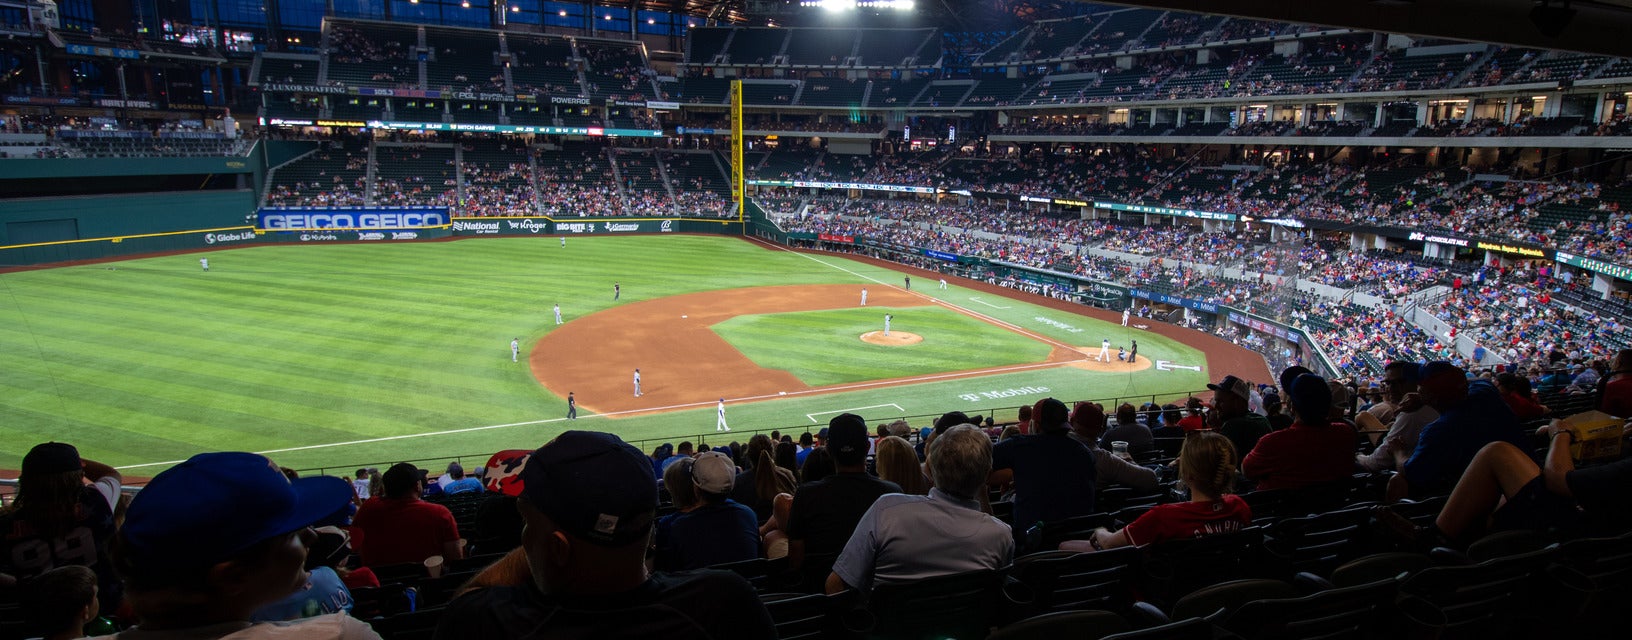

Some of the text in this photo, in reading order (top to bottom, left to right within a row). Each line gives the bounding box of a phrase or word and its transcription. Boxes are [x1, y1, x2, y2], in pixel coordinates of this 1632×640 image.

[272, 84, 346, 94] LUXOR STAFFING
[264, 213, 443, 229] GEICO GEICO
[464, 222, 500, 230] National
[520, 218, 546, 233] Kroger
[556, 222, 569, 230] BIG
[217, 232, 256, 242] Globe Life
[1200, 303, 1216, 311] Mitel
[979, 386, 1051, 399] Mobile
